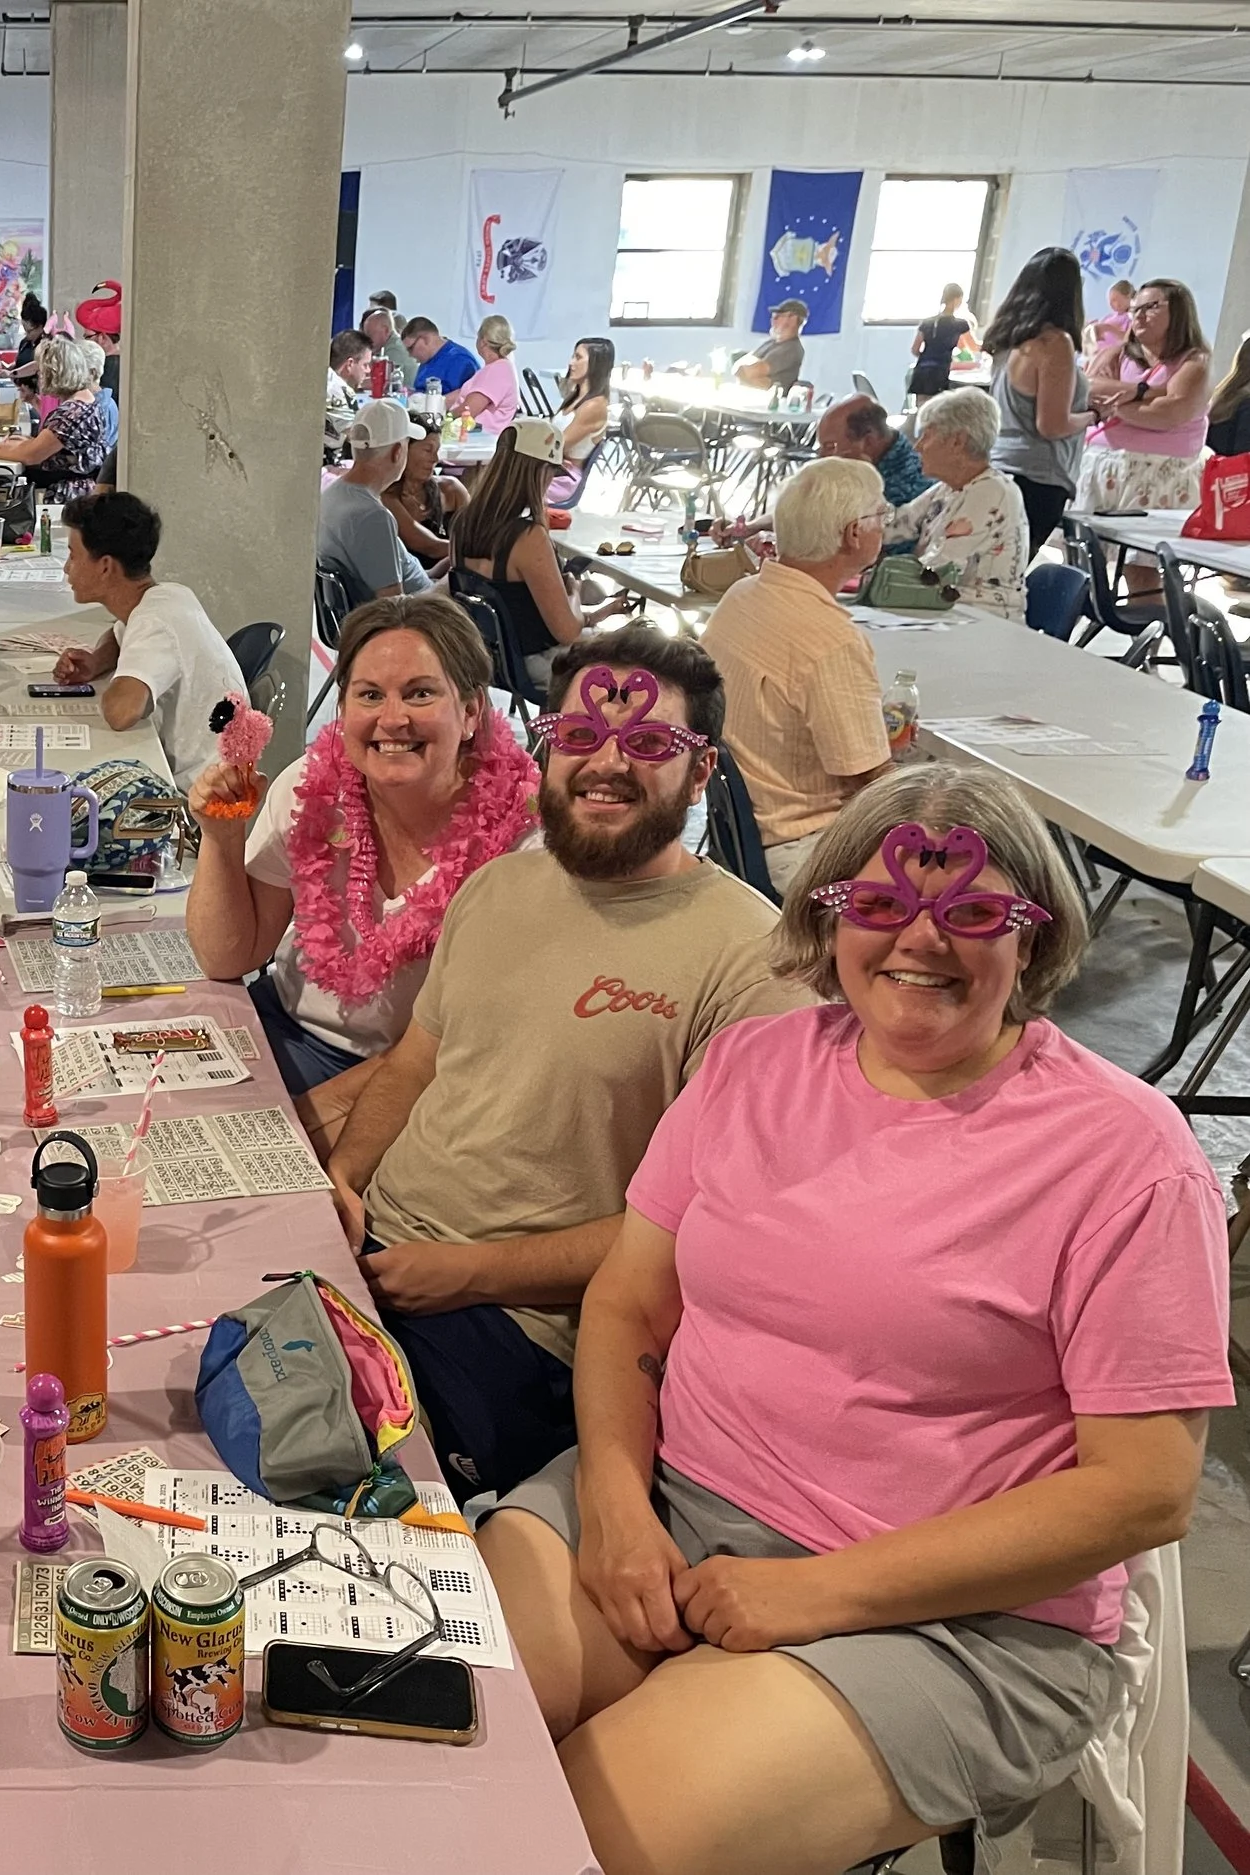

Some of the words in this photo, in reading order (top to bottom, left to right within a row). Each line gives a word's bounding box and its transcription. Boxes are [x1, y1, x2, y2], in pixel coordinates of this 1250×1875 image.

[574, 975, 678, 1019] Coors
[50, 1488, 63, 1496] THE
[36, 1567, 50, 1580] 73
[36, 1583, 49, 1596] 50
[35, 1601, 48, 1612] 31
[187, 1610, 217, 1622] Employee
[217, 1601, 235, 1616] Owned
[35, 1615, 48, 1628] 26
[93, 1614, 109, 1626] ONLY
[34, 1632, 48, 1645] 12
[160, 1618, 193, 1646] New
[196, 1620, 243, 1648] Glarus
[198, 1645, 232, 1658] Brewing
[88, 1682, 107, 1712] ONLY
[66, 1705, 95, 1727] Cow
[161, 1700, 214, 1723] Spotted
